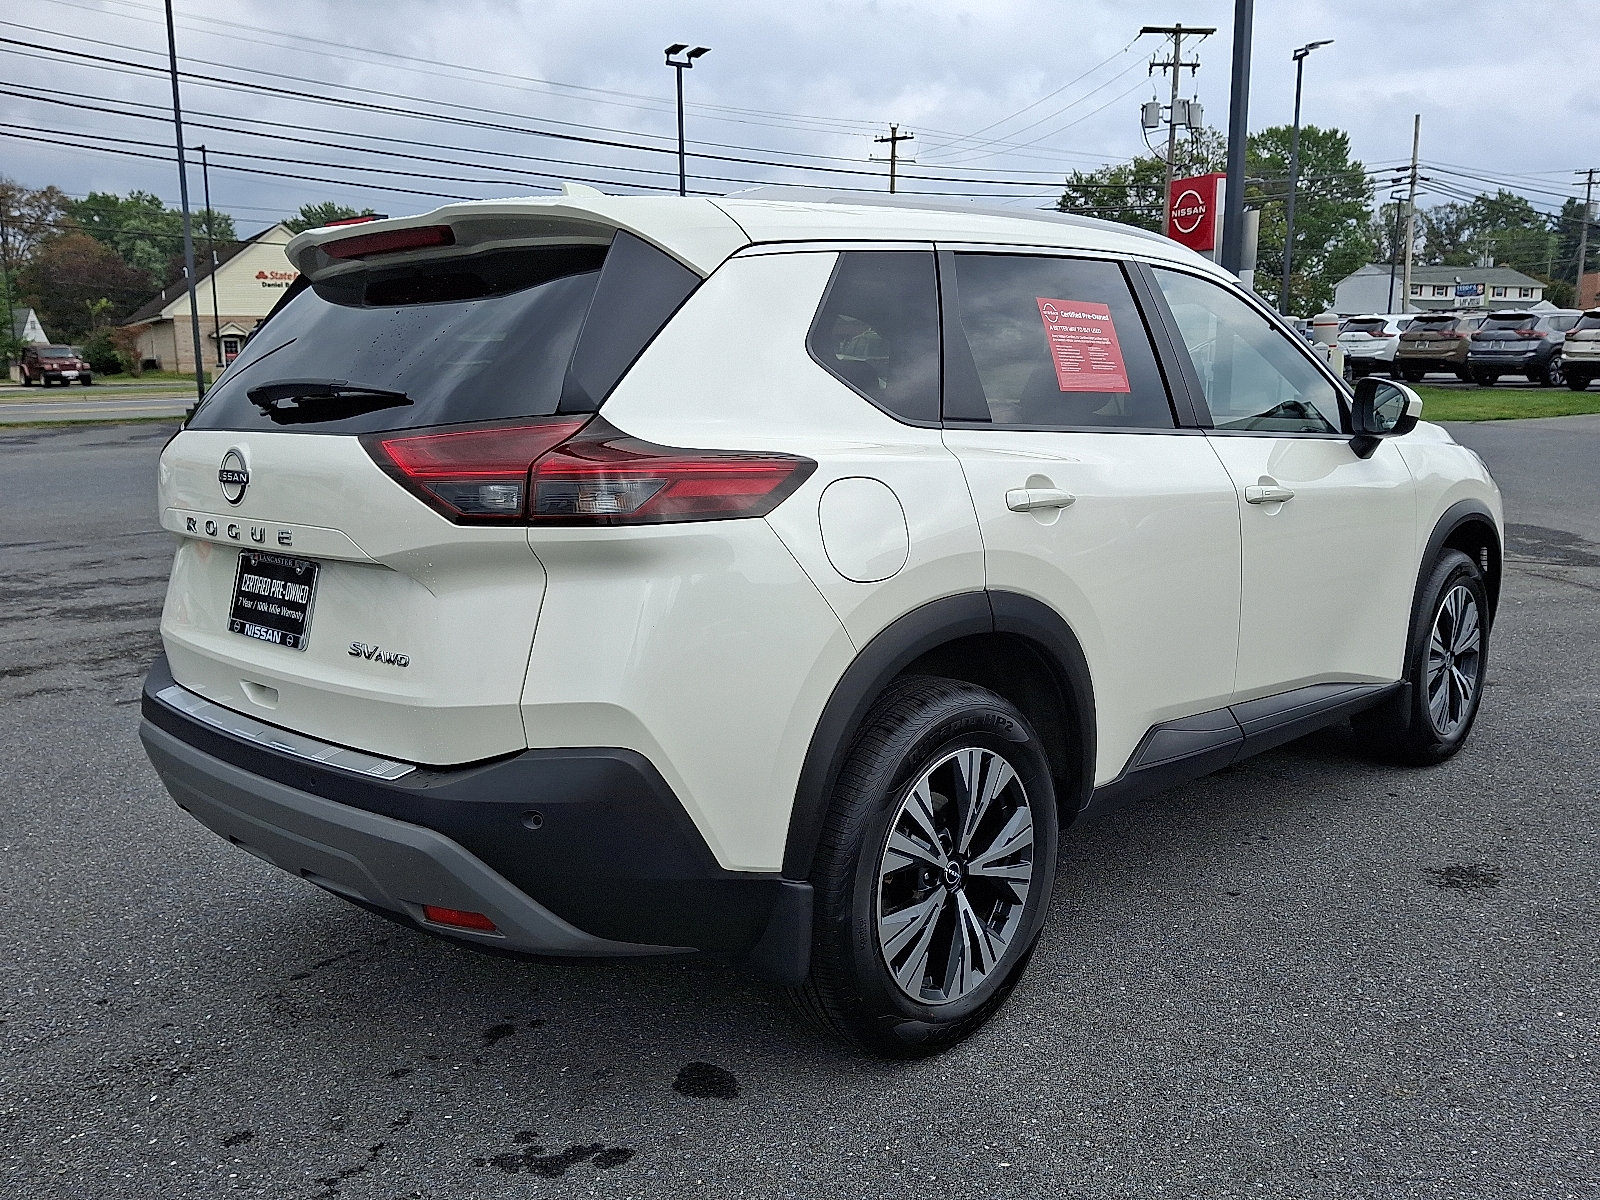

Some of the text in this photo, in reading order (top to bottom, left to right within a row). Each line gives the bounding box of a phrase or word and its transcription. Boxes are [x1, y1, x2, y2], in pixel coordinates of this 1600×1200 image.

[1172, 205, 1206, 218] NISSAN
[270, 271, 292, 279] State
[1060, 311, 1110, 321] Certified Pre-Owned
[186, 517, 293, 546] ROGUE
[259, 554, 294, 567] LANCASTER
[241, 574, 309, 604] CERTIFIED PRE-OWNED
[238, 597, 242, 606] 7
[242, 597, 253, 609] Year
[269, 604, 281, 616] Mile
[281, 606, 304, 622] Warranty
[244, 623, 281, 643] NISSAN
[348, 641, 410, 669] SV AWD
